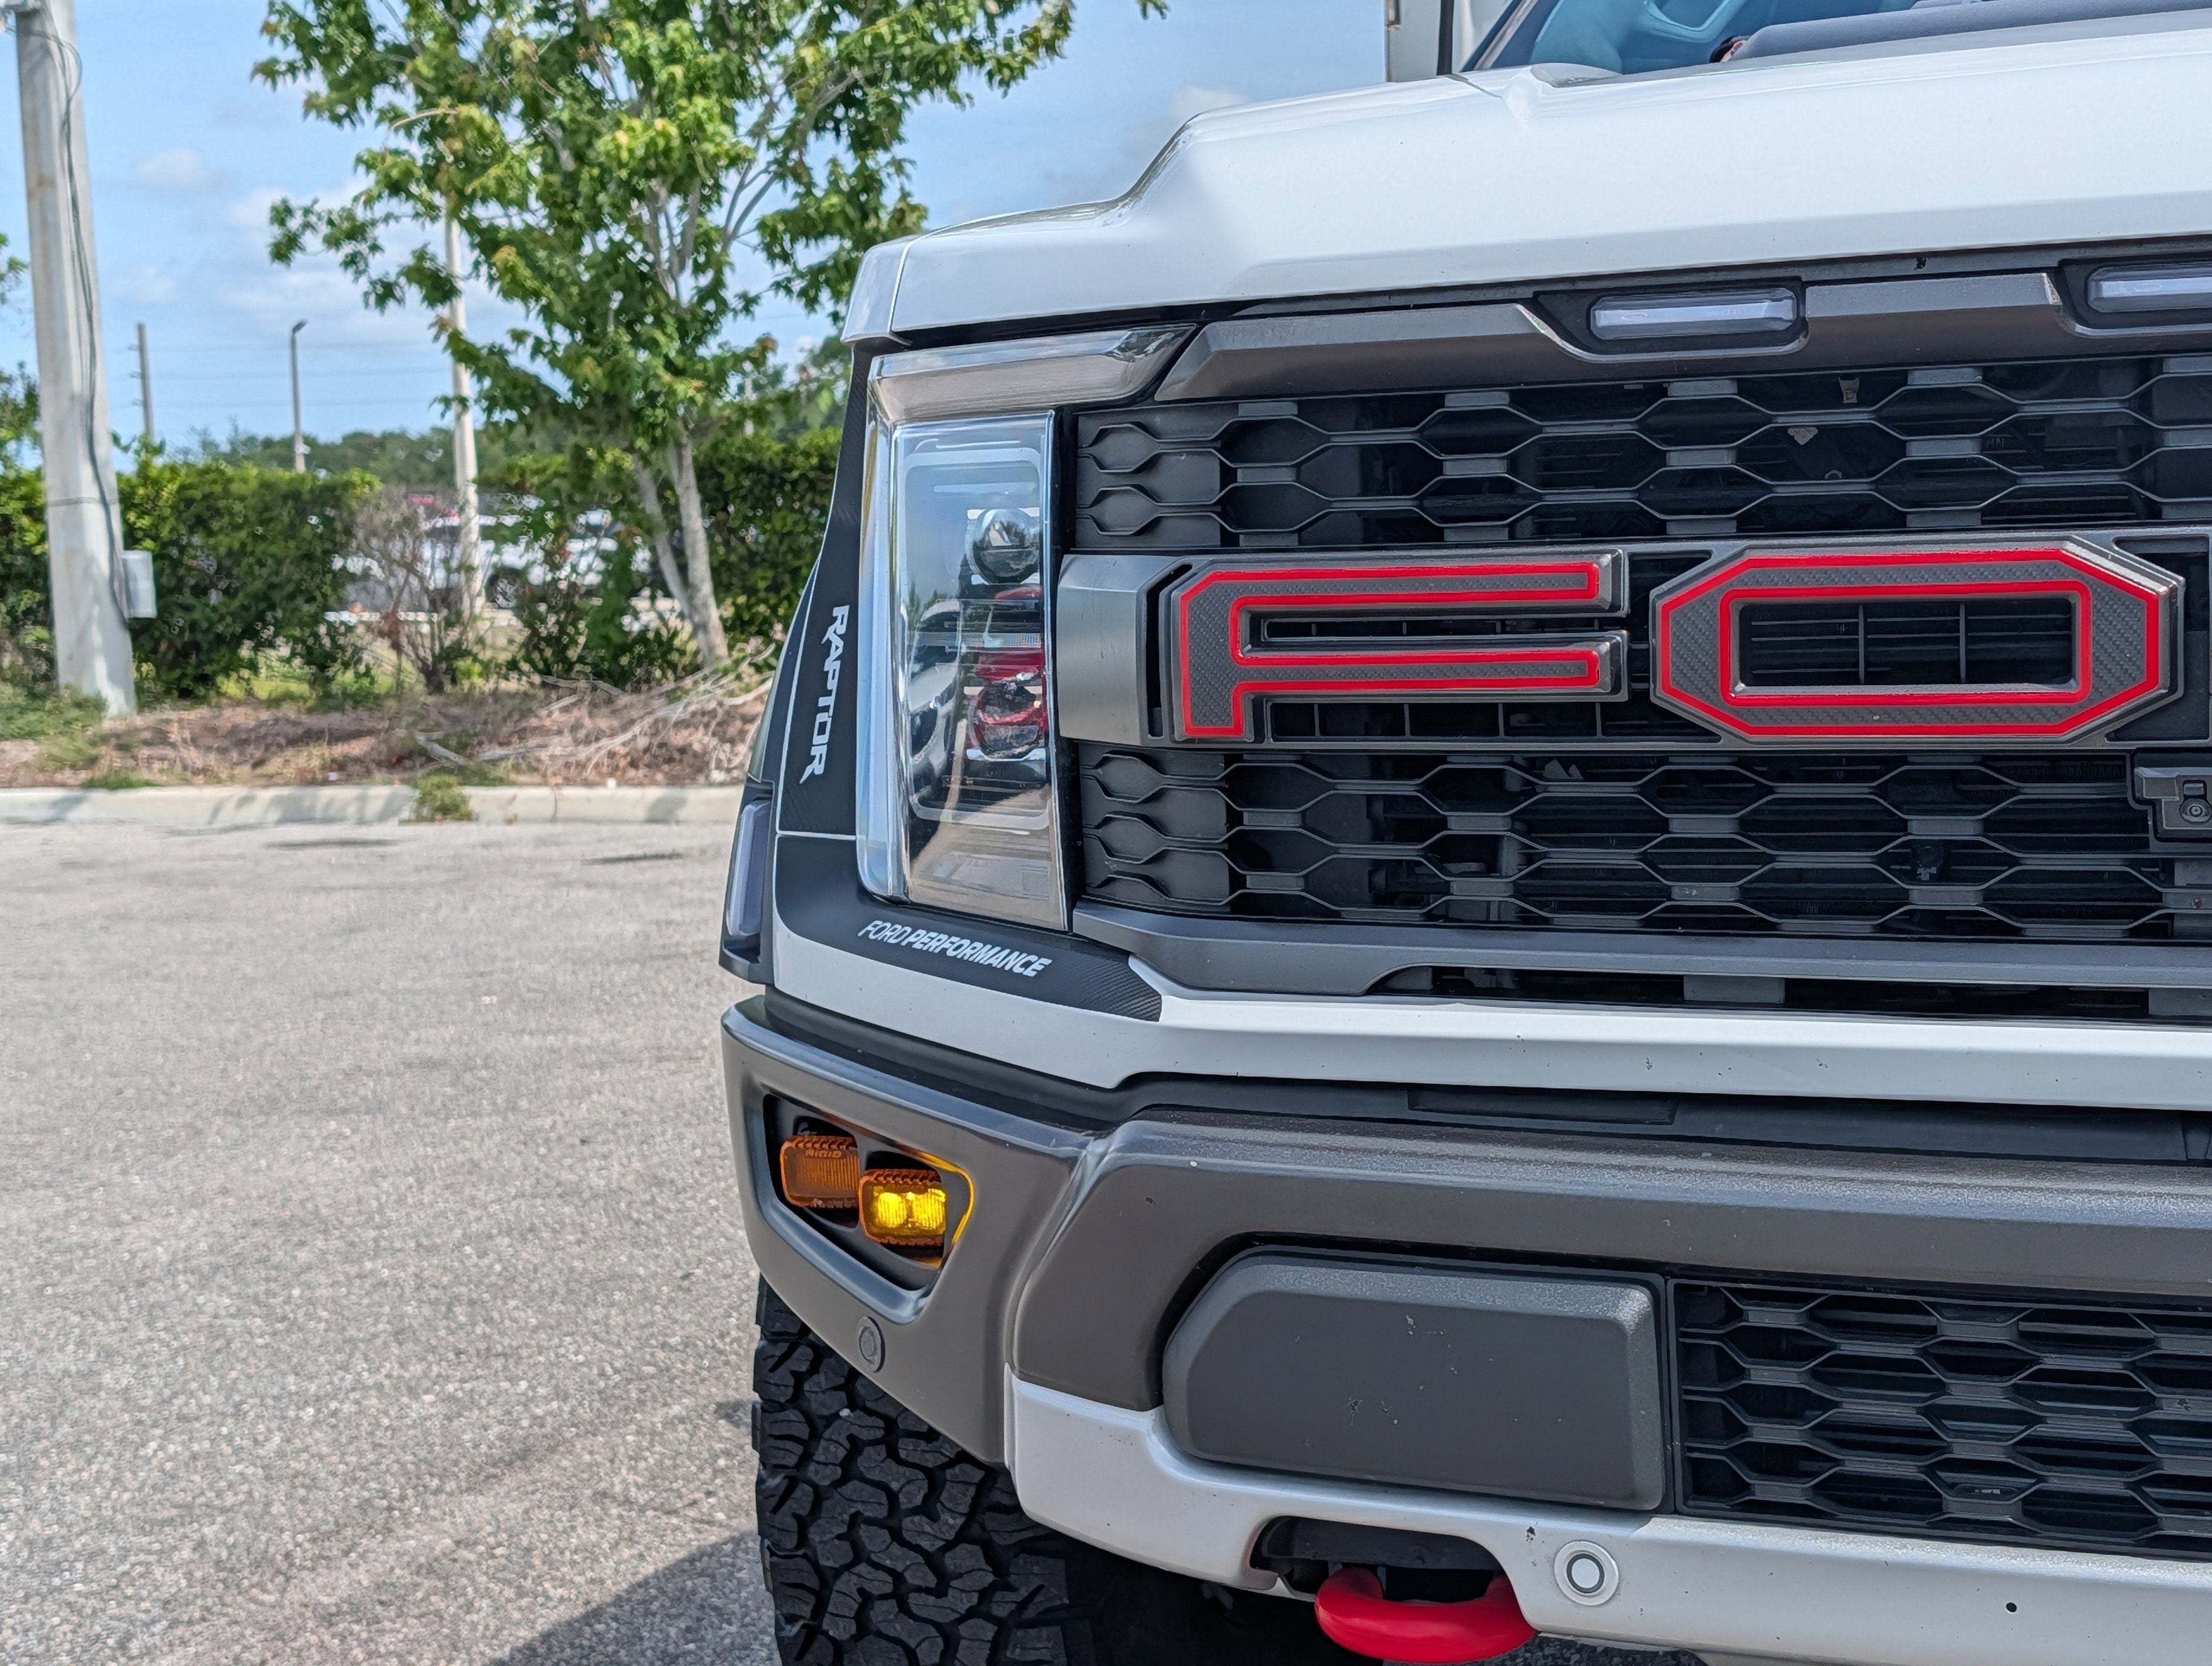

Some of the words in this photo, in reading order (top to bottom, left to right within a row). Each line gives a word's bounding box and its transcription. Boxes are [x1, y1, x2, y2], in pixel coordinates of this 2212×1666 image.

[799, 605, 850, 784] RAPTOR
[857, 920, 912, 944] FORD
[900, 928, 1053, 977] PERFORMANCE
